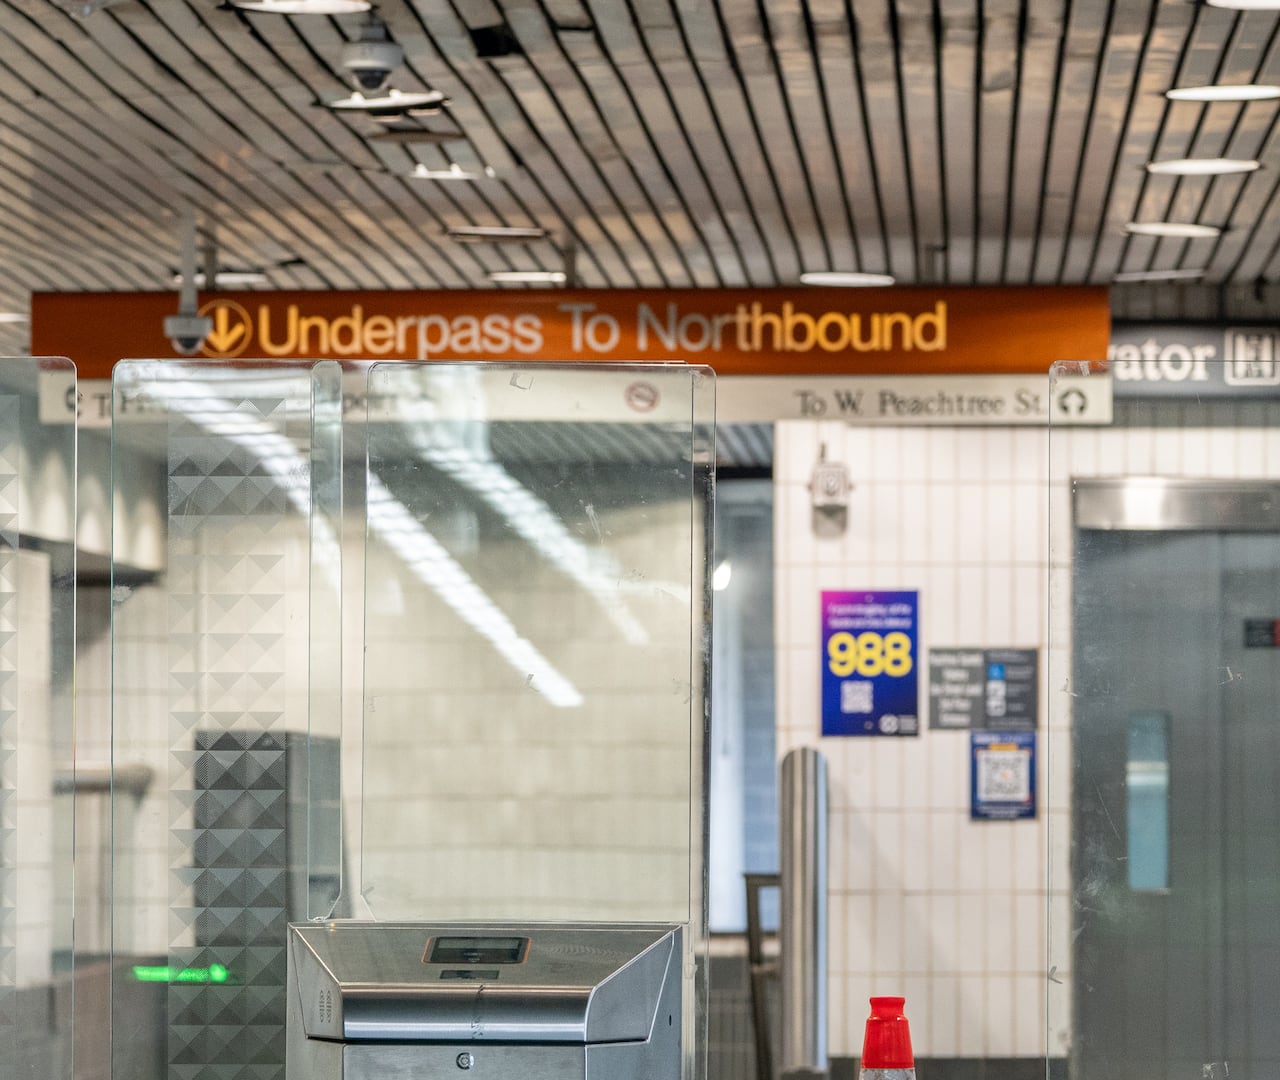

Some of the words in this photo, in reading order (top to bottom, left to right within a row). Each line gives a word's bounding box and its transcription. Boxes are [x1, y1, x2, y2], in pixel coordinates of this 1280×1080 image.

[258, 303, 544, 360] Underpass
[560, 303, 620, 354] To
[637, 301, 948, 353] Northbound
[795, 389, 827, 416] To
[832, 389, 864, 416] W.
[878, 389, 1008, 416] Peachtree
[1014, 388, 1047, 415] St.
[827, 631, 913, 678] 988
